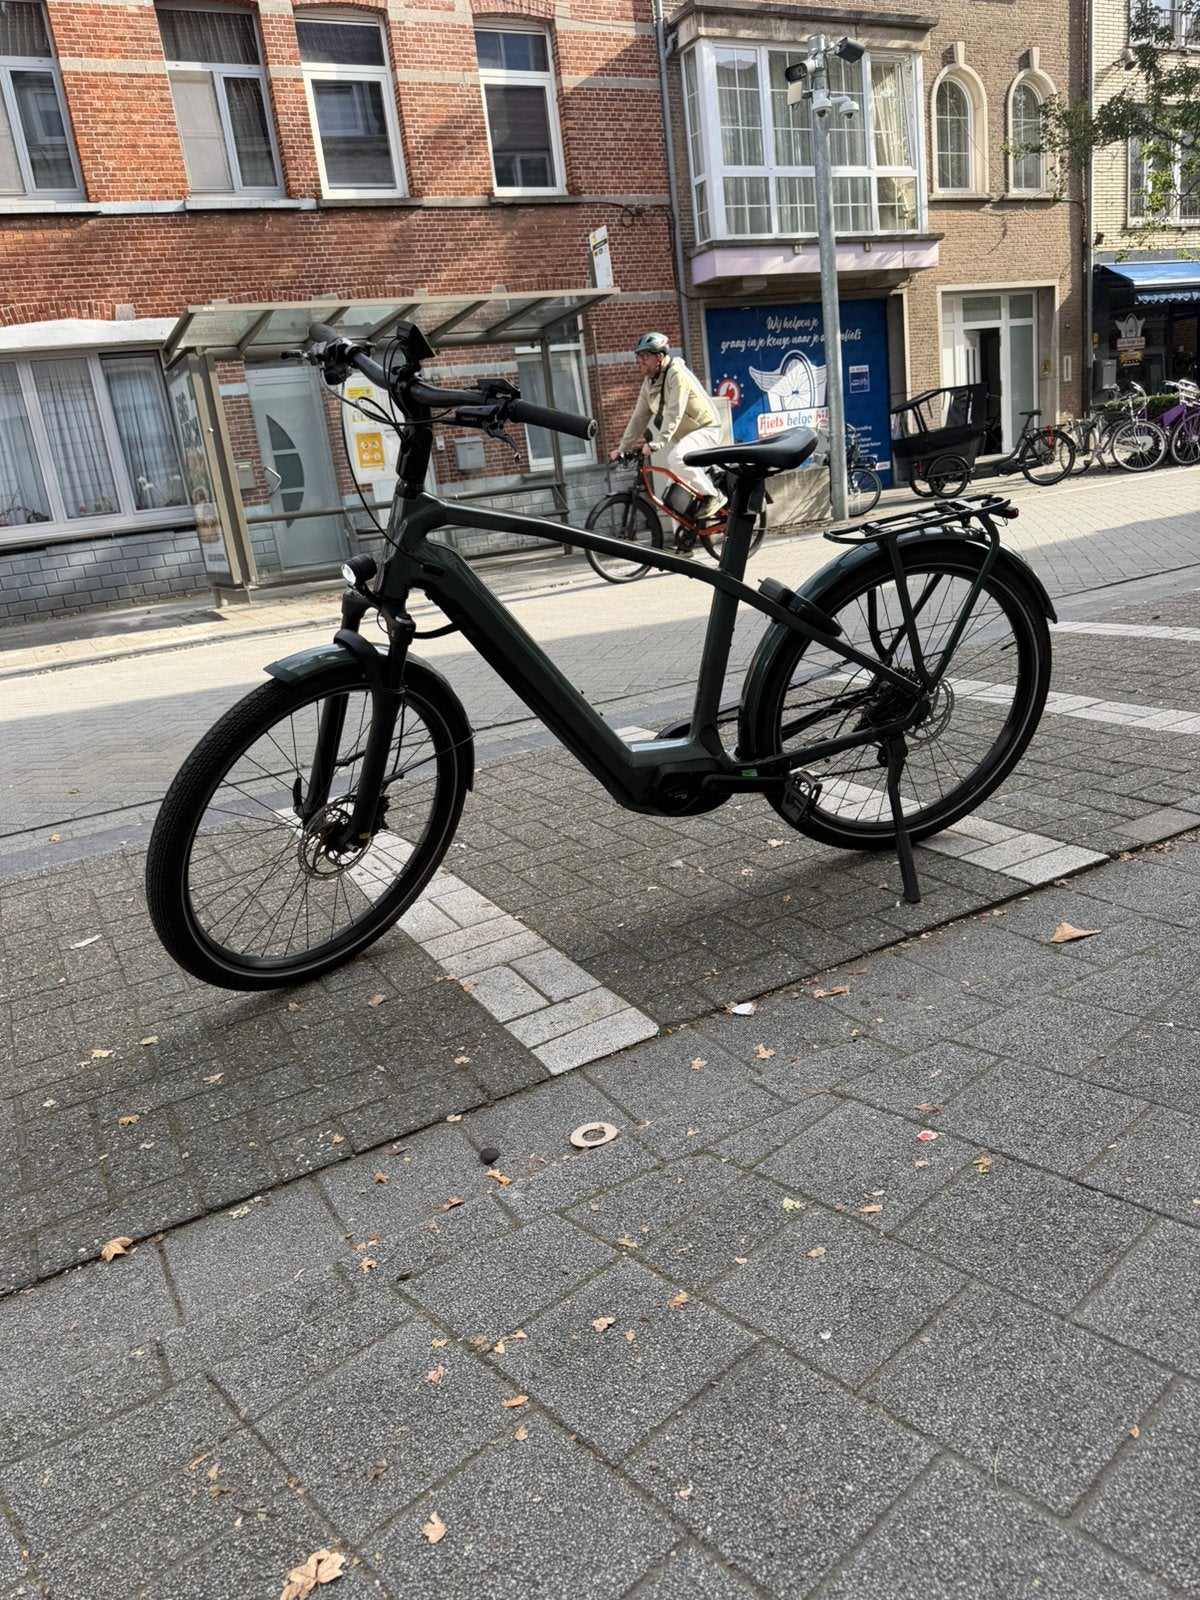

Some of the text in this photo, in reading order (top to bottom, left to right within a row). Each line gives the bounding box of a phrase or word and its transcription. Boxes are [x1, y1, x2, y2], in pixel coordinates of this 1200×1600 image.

[766, 315, 819, 333] Wij helpen je
[721, 340, 746, 354] graag
[747, 337, 756, 347] in
[755, 338, 766, 351] je
[792, 335, 811, 344] naar
[809, 333, 819, 346] je
[760, 415, 783, 430] Fiets
